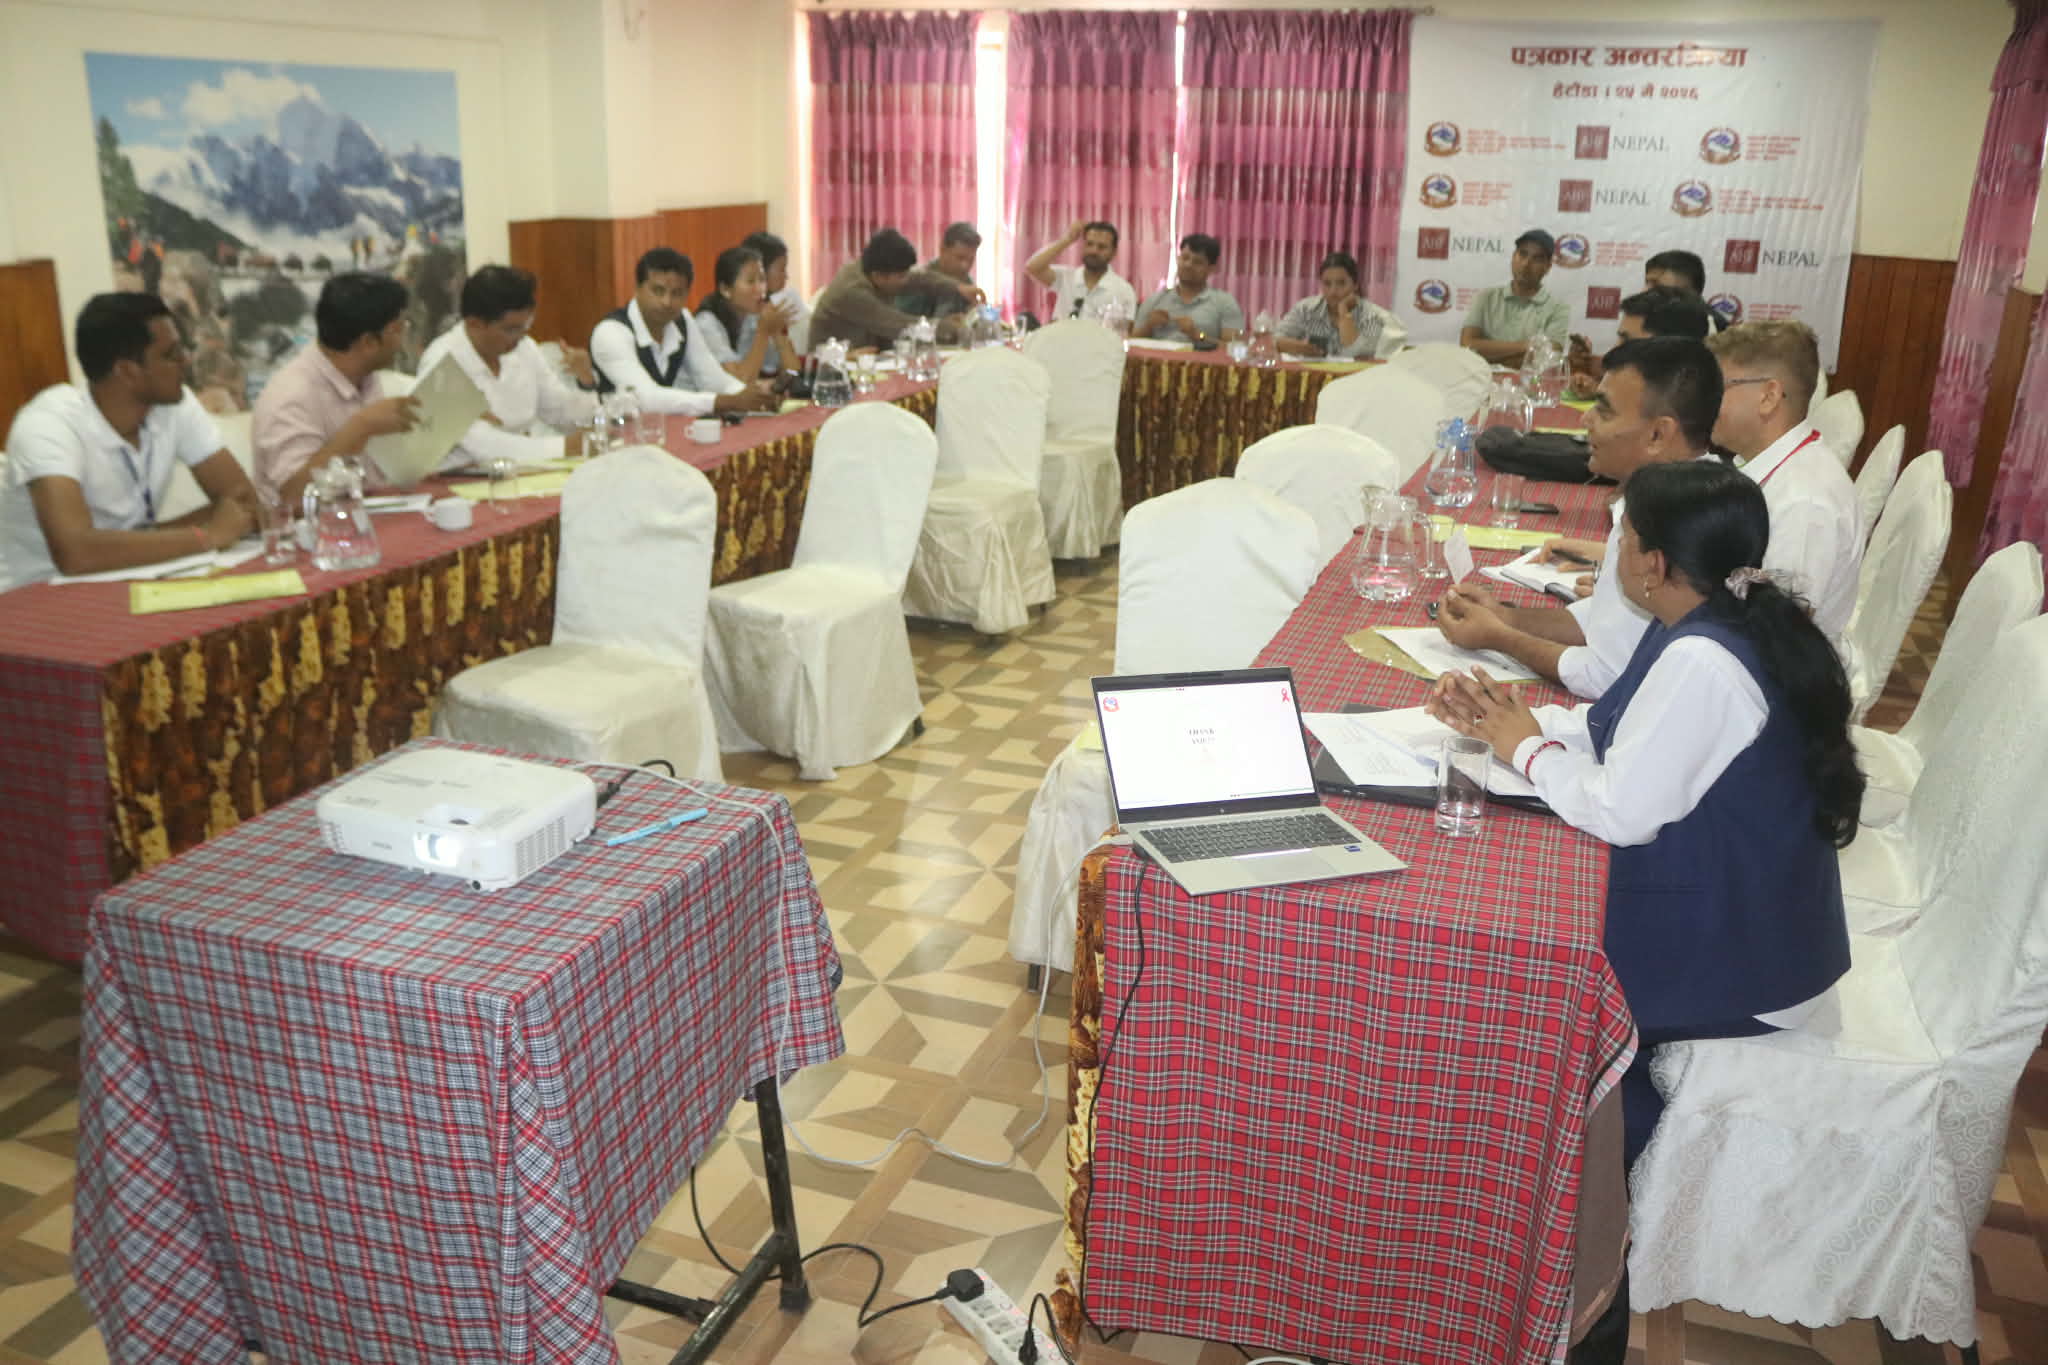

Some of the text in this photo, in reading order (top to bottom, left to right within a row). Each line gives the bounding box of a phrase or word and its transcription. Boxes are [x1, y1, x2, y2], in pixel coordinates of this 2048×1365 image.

[1510, 46, 1595, 68] पत्रकार
[1612, 135, 1670, 151] NEPAL
[1595, 190, 1650, 206] NEPAL
[1452, 236, 1504, 253] NEPAL
[1762, 249, 1820, 267] NEPAL
